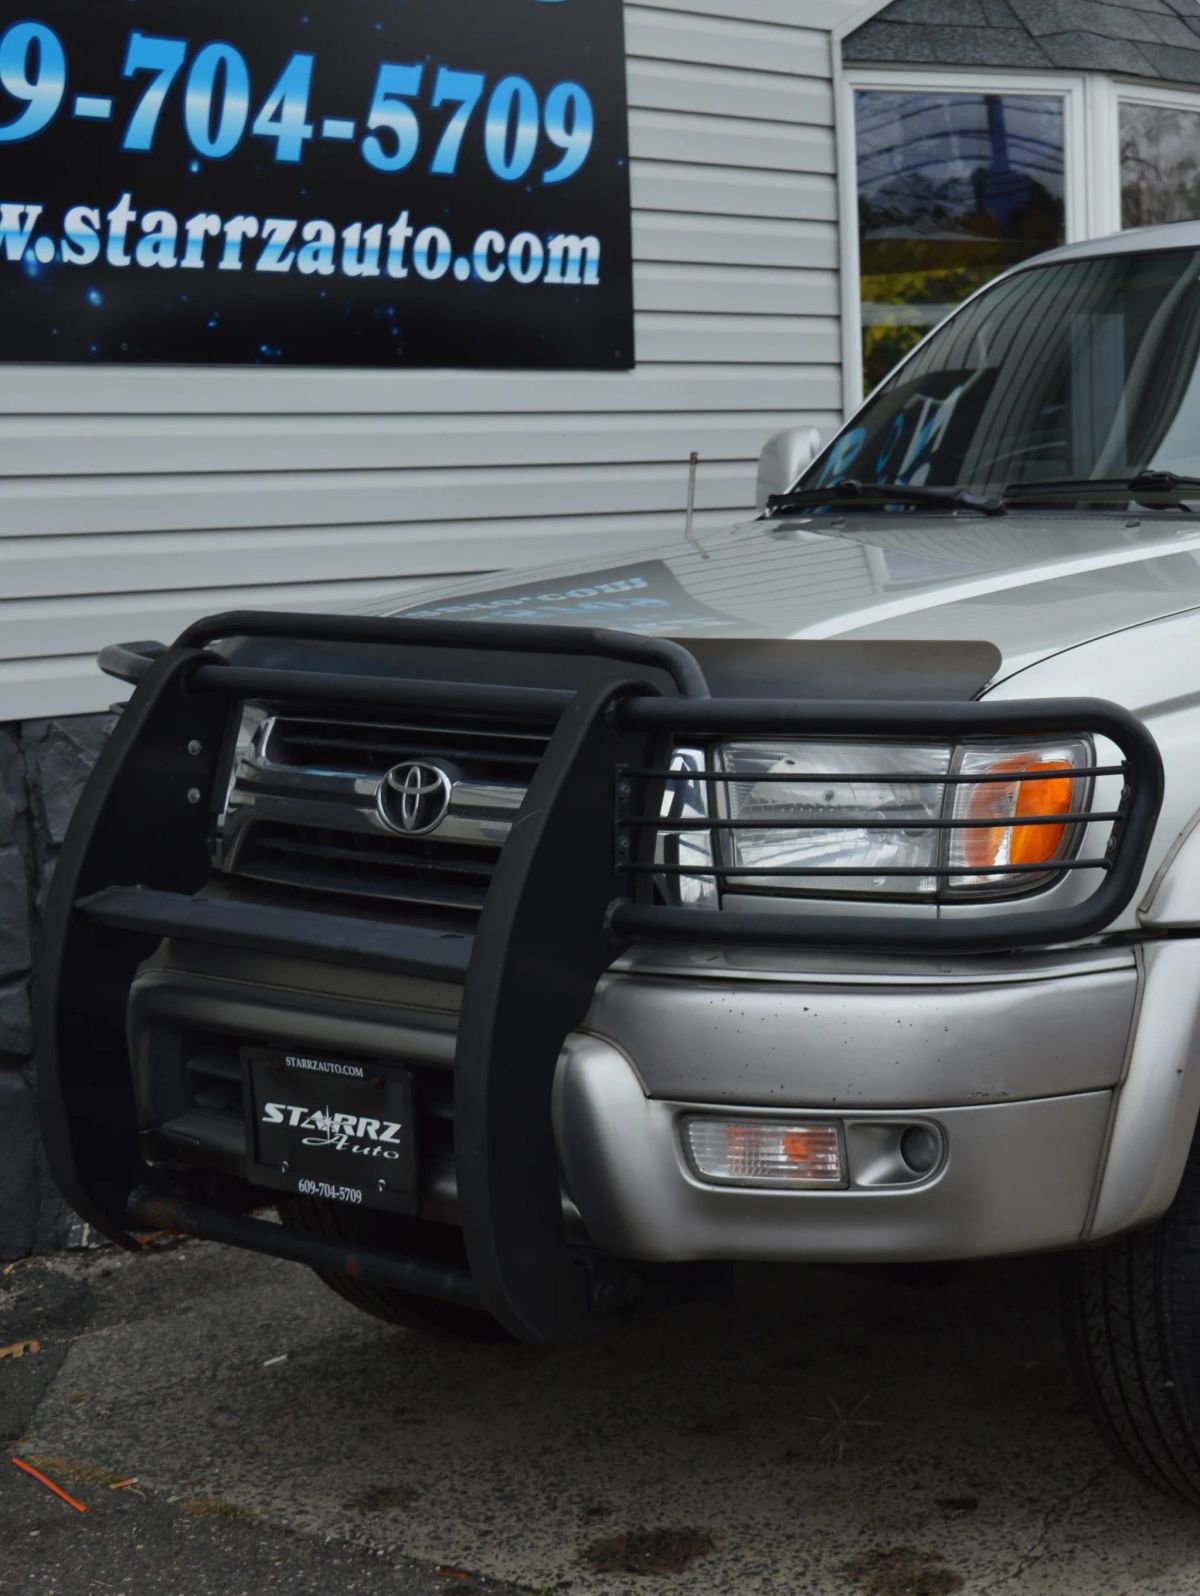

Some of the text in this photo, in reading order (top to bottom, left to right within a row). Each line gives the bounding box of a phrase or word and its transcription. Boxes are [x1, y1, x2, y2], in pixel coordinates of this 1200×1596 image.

[0, 20, 595, 184] 9-704-5709
[285, 1056, 364, 1078] STARRZAUTO.COM
[262, 1102, 402, 1144] STARRZ
[301, 1132, 400, 1160] Auto
[298, 1178, 363, 1204] 609-704-5709
